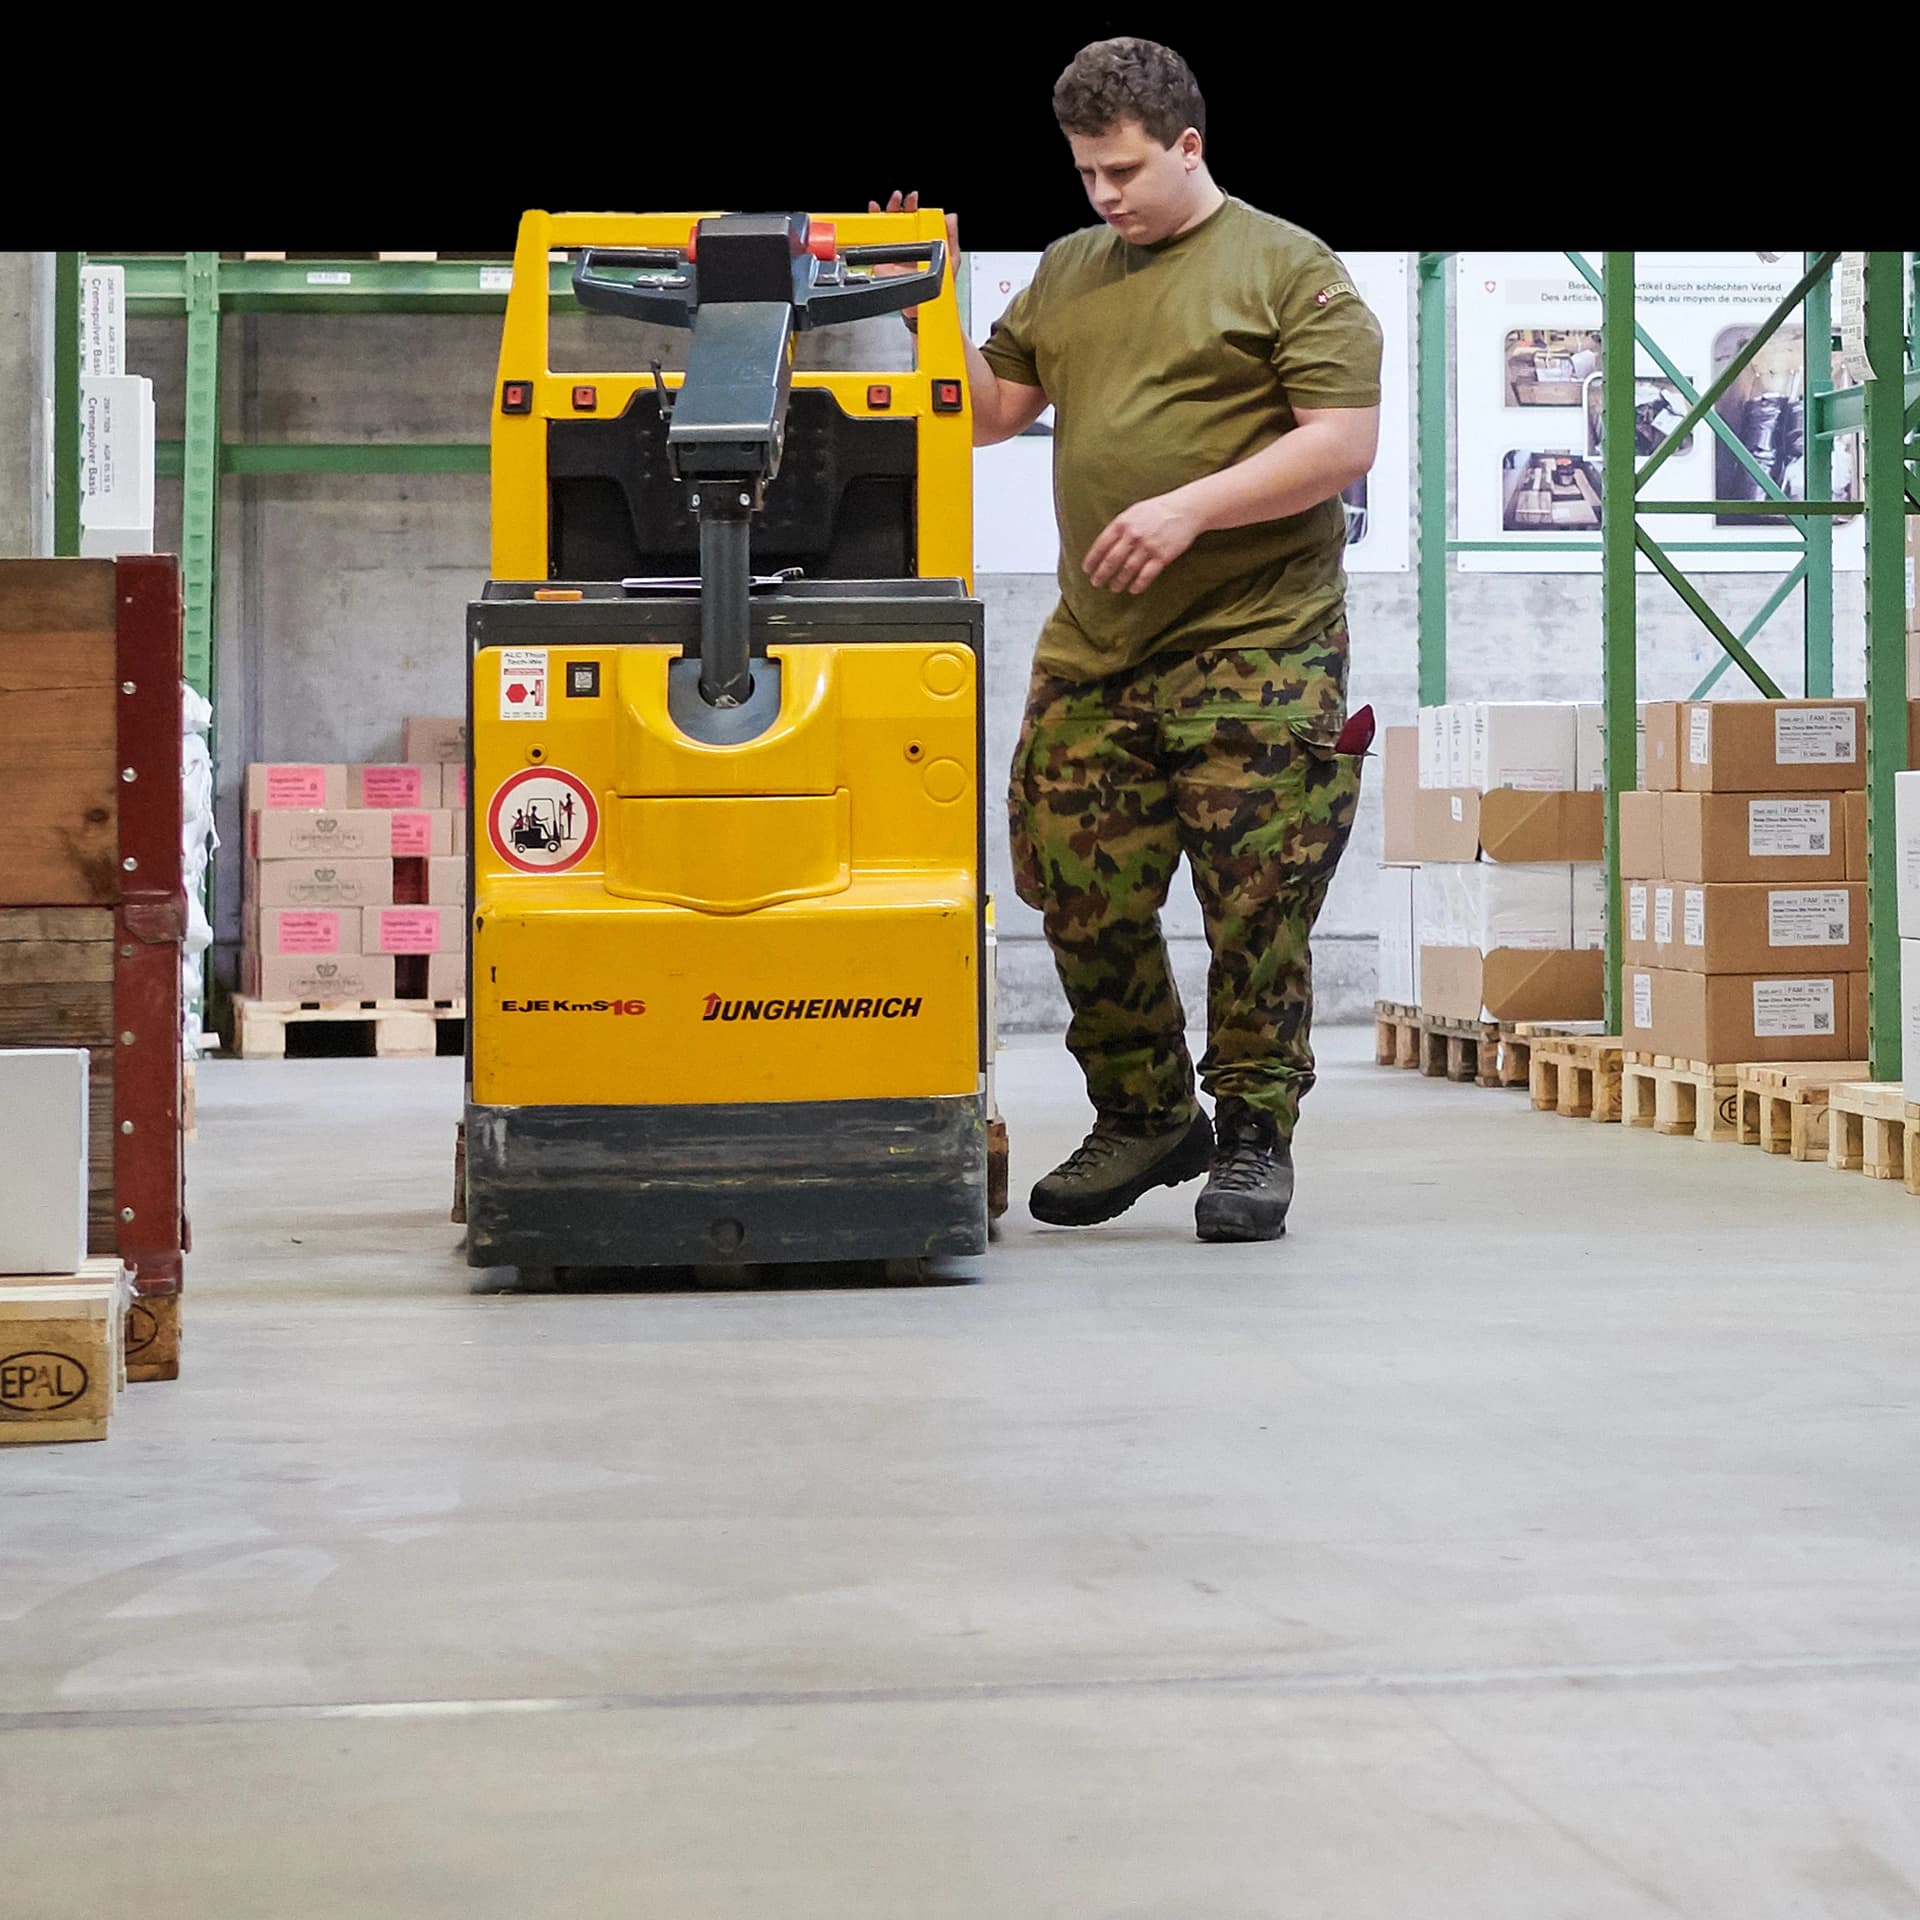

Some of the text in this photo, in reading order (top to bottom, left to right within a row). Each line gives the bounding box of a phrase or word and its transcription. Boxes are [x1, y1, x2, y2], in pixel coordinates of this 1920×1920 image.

[1634, 282, 1663, 291] rtikel
[1665, 282, 1693, 291] durch
[1696, 282, 1749, 291] schlechten
[1541, 293, 1560, 302] Des
[1562, 293, 1598, 302] articles
[1683, 295, 1715, 305] moyen
[1718, 294, 1730, 303] de
[1734, 294, 1773, 303] mauvais
[87, 397, 98, 496] Cremepulver Basis
[501, 1000, 550, 1012] EJE
[702, 993, 923, 1021] JUNGHEINRICH
[1, 1365, 73, 1398] EPAL
